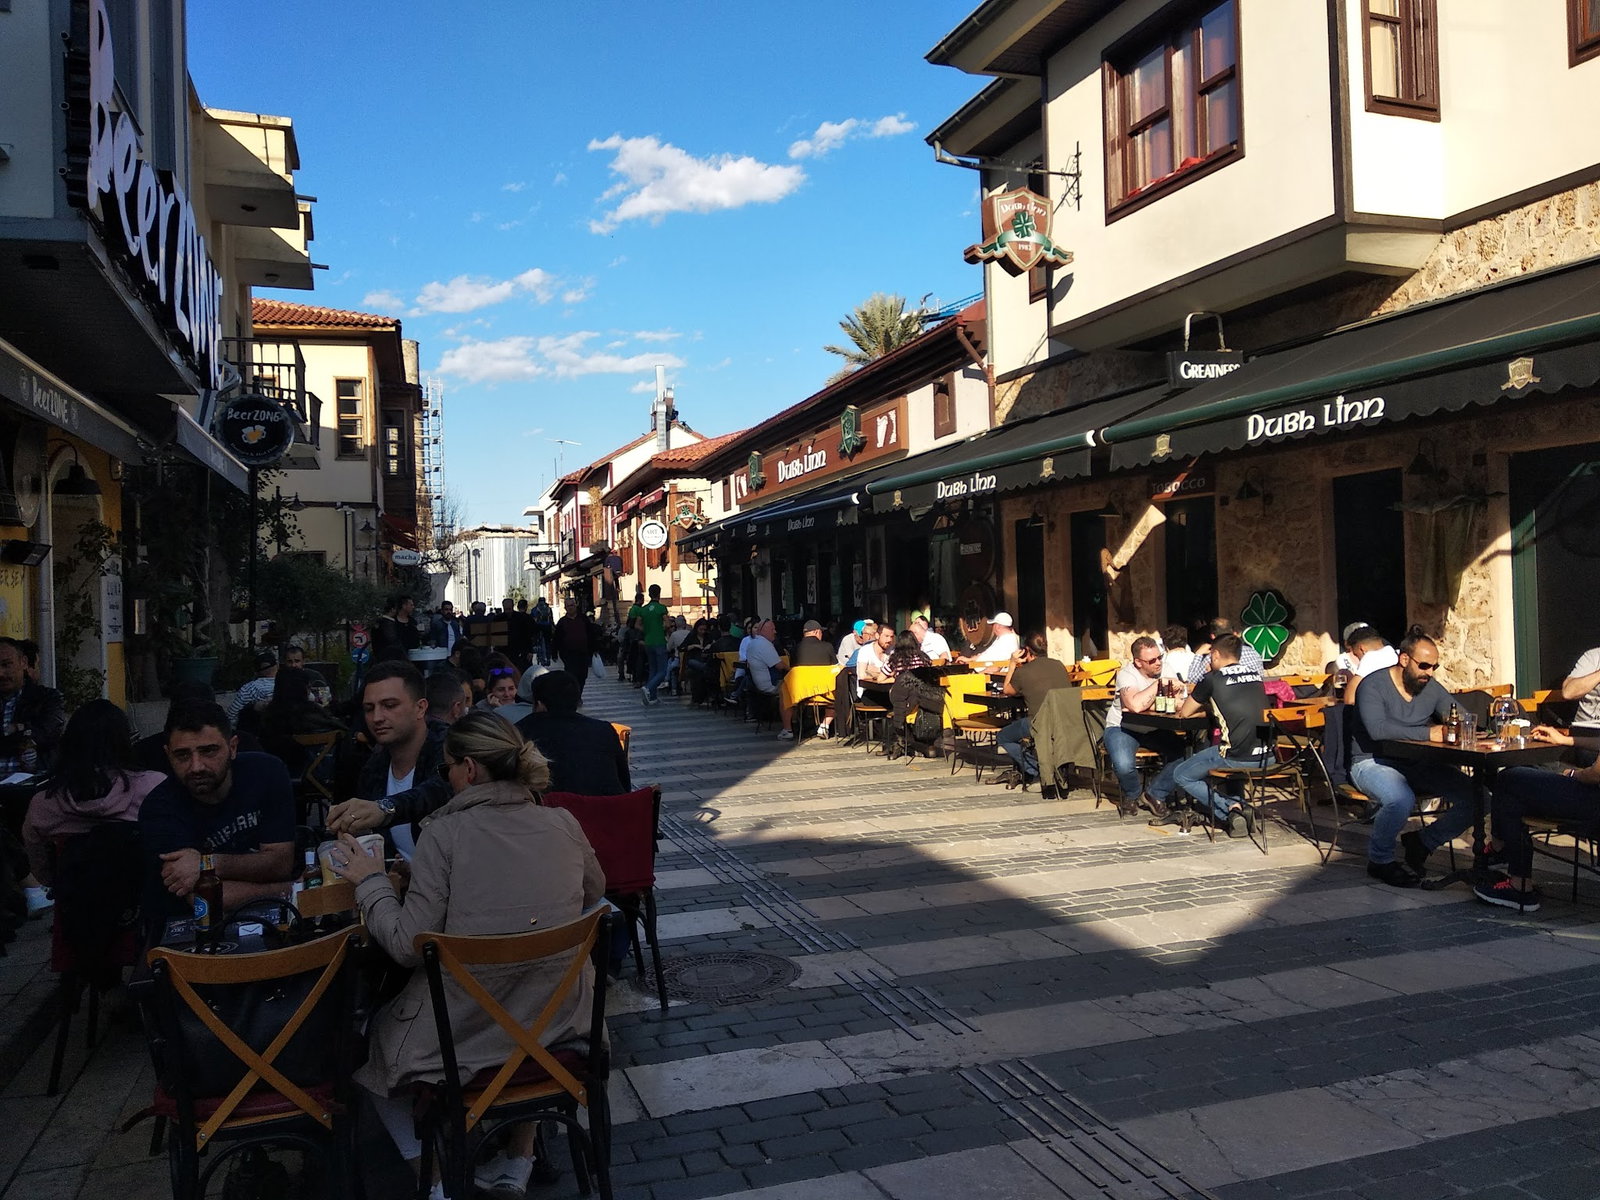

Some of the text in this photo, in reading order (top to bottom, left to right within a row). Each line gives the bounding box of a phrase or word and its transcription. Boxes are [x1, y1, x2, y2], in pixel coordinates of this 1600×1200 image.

[1323, 395, 1385, 427] Linn
[804, 445, 827, 474] Linn
[970, 472, 996, 493] Linn
[394, 553, 417, 561] macha
